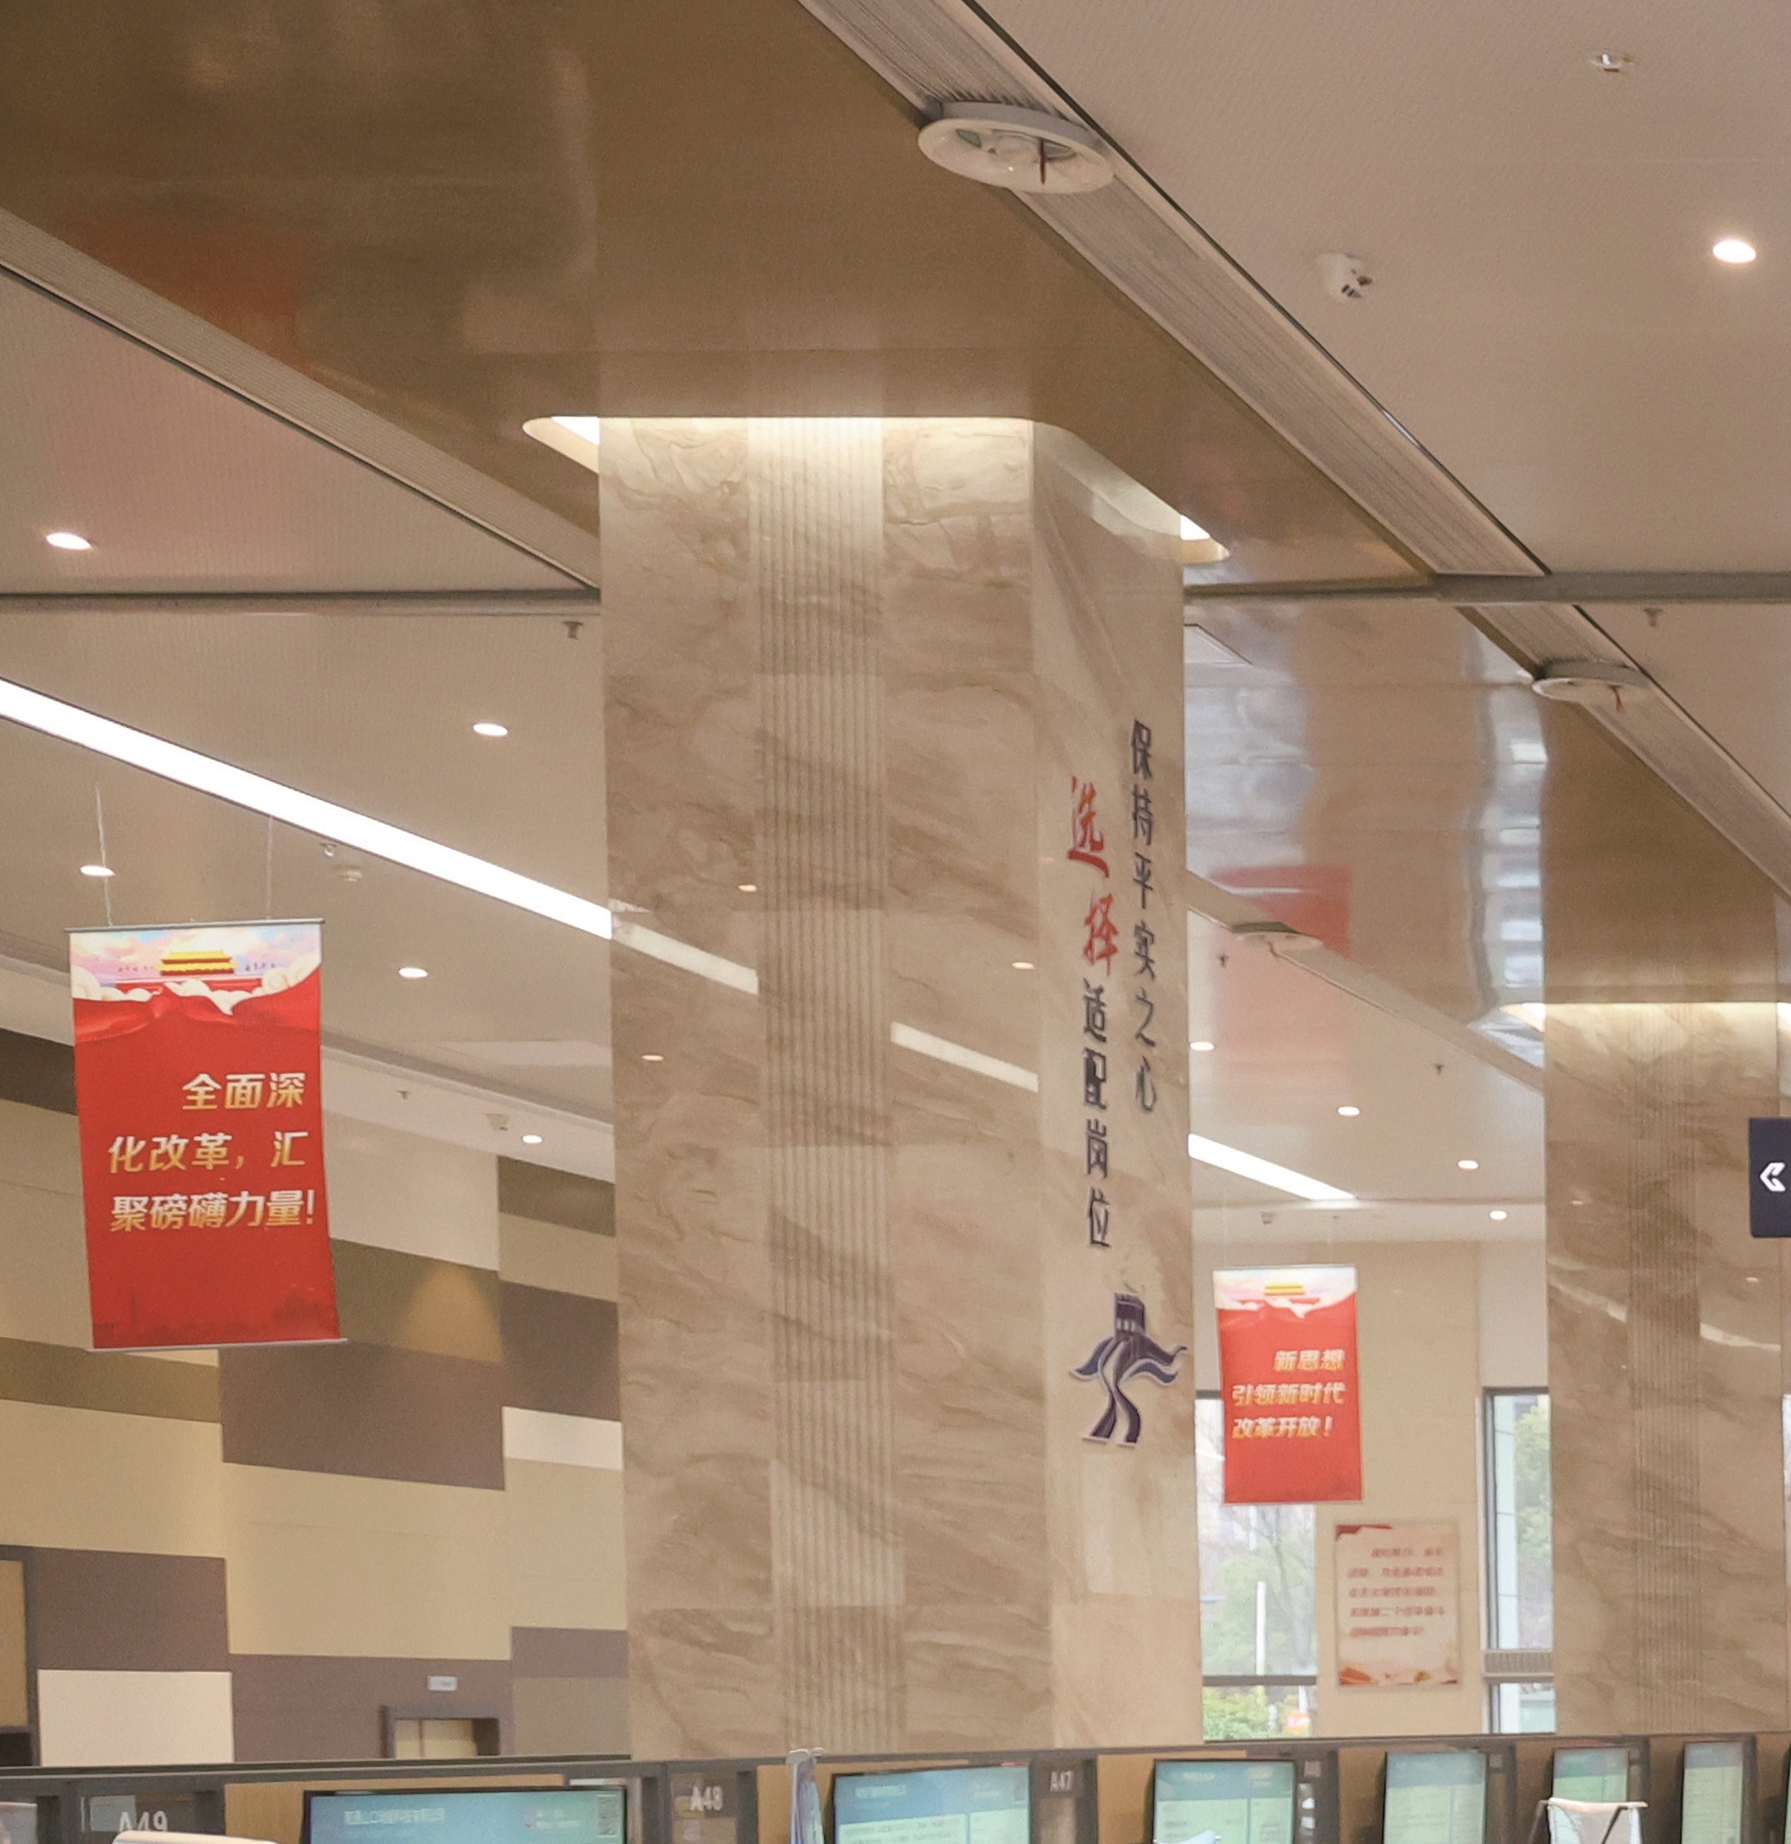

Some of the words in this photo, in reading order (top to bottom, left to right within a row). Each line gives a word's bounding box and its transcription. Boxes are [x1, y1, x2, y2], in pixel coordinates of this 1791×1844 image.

[182, 1072, 306, 1111] 全面深
[108, 1131, 309, 1174] 化改革，汇
[1049, 1770, 1073, 1792] A47
